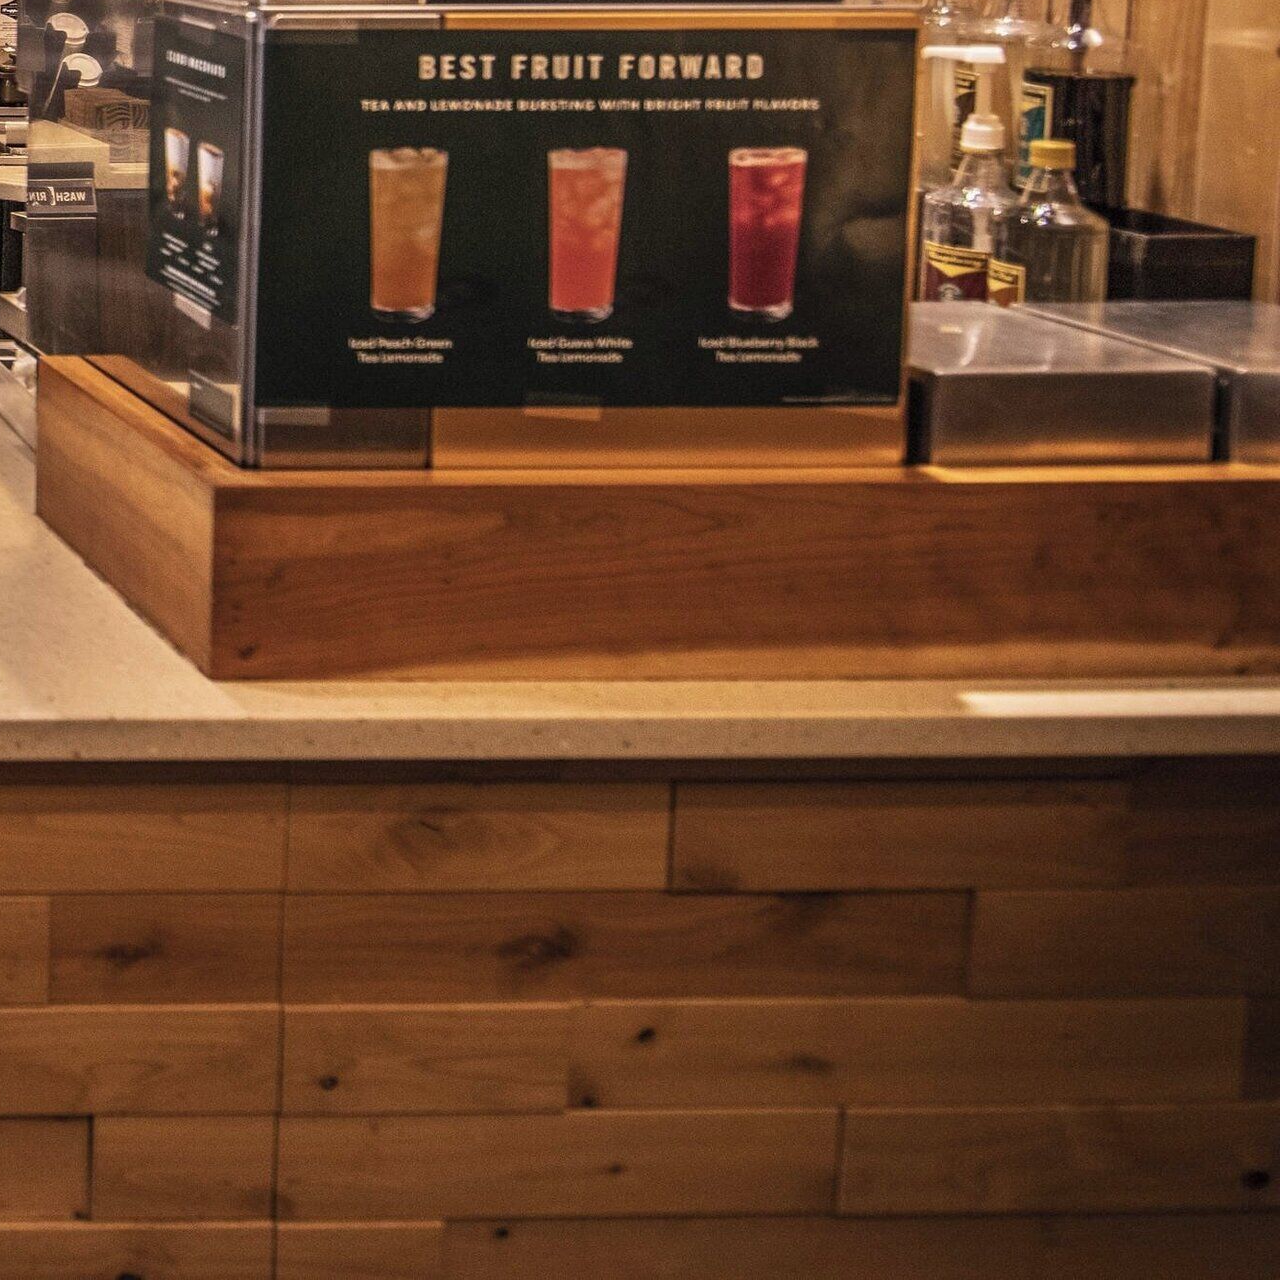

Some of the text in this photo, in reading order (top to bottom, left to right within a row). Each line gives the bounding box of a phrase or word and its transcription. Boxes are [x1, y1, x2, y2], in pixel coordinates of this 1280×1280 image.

[418, 54, 765, 80] BEST FRUIT FORWARD
[361, 99, 389, 111] TEA
[393, 100, 426, 110] AND
[598, 100, 640, 110] WITH
